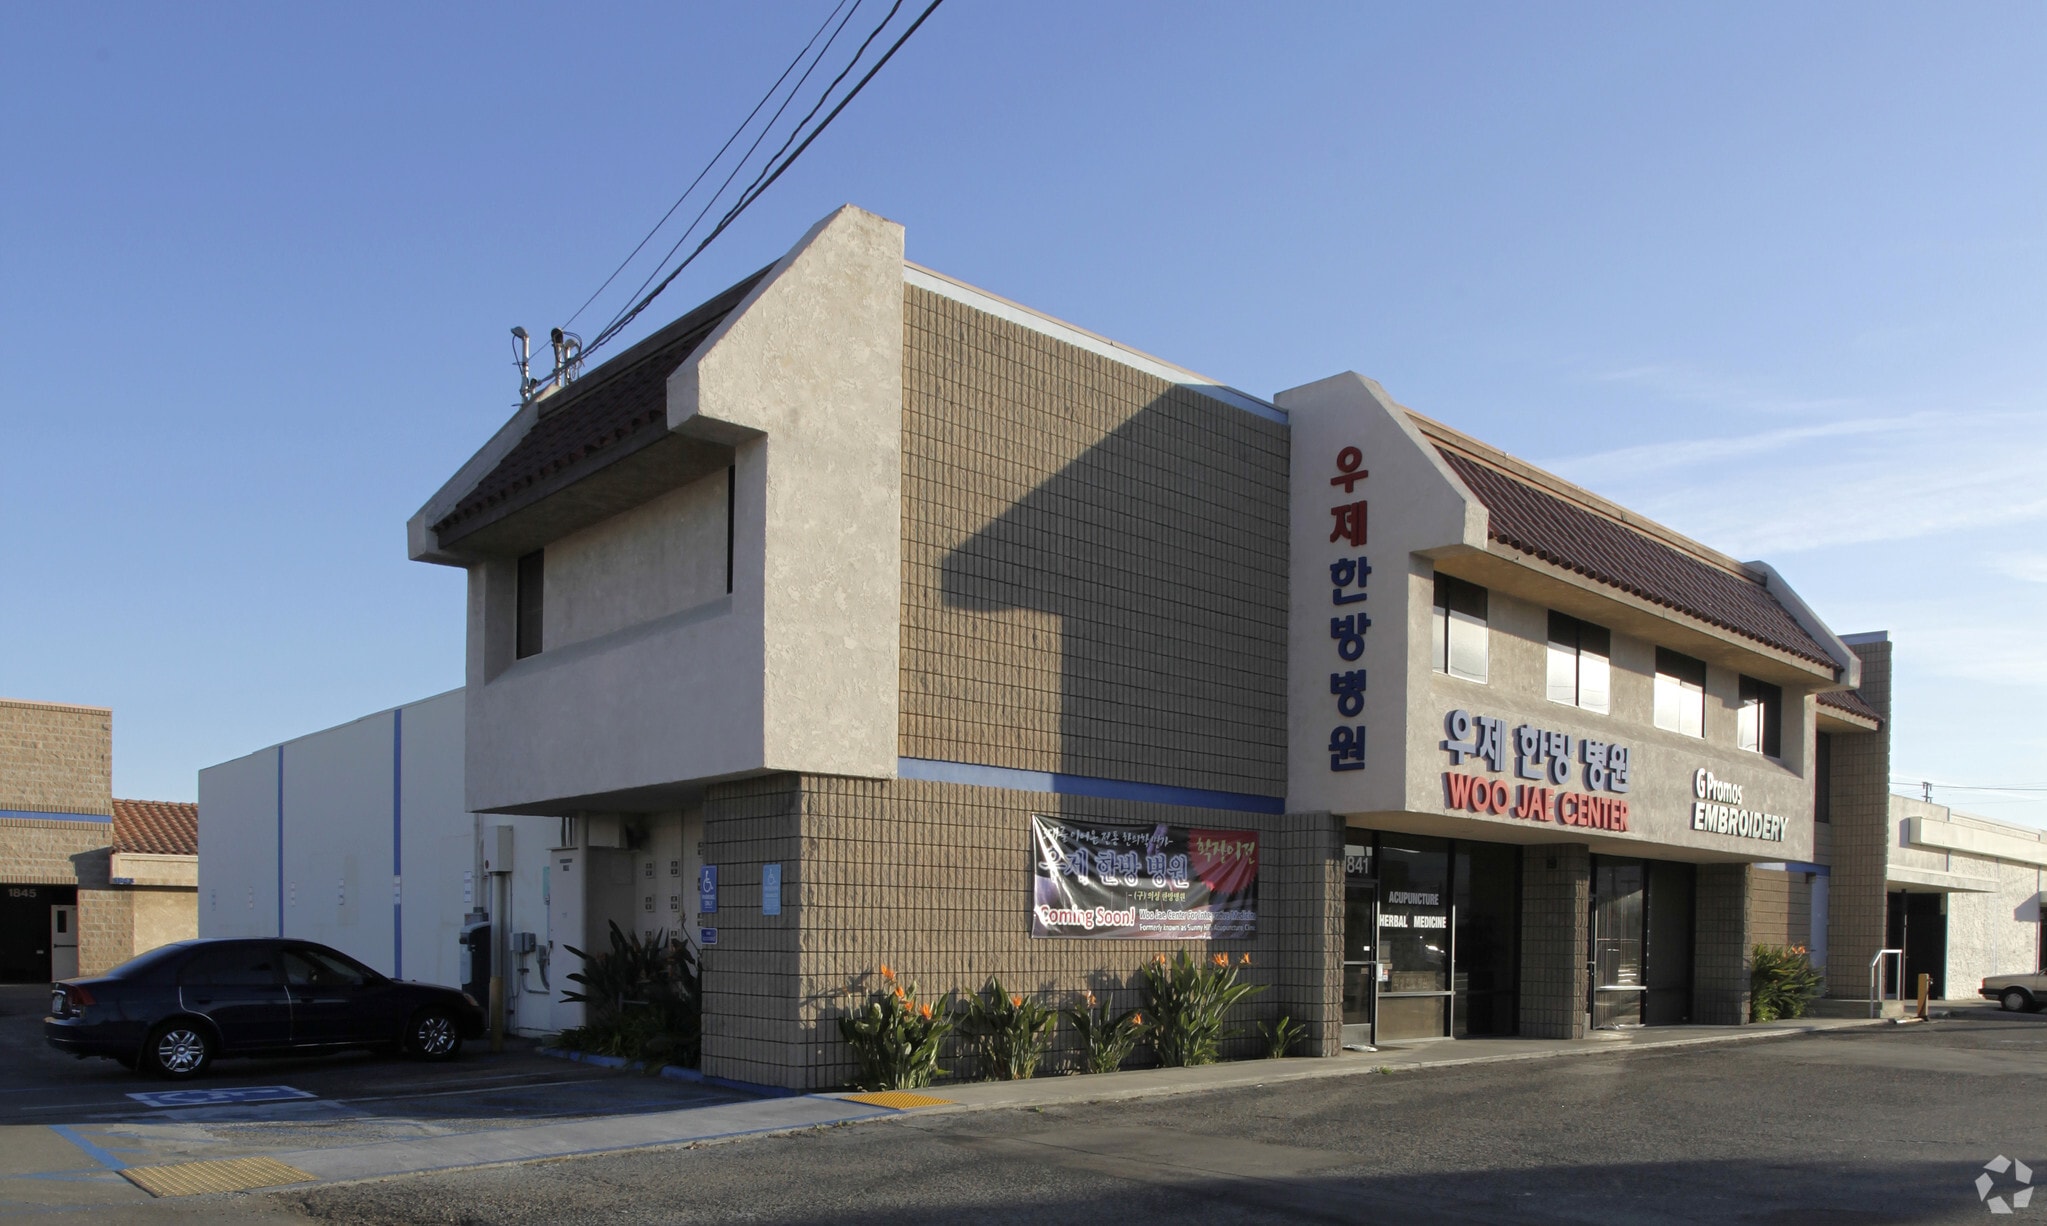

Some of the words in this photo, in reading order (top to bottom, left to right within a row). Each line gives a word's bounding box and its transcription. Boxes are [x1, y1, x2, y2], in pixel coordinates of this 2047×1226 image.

[1440, 709, 1507, 772] 우제
[1513, 724, 1575, 785] 한방
[1579, 739, 1631, 793] 병원
[1707, 771, 1743, 805] Promos
[1444, 772, 1510, 815] WOO
[1513, 784, 1555, 821] JAE
[1558, 791, 1630, 831] CENTER
[1693, 801, 1790, 842] EMBROIDERY
[1096, 851, 1142, 886] 한방
[1147, 853, 1189, 888] 병원
[8, 888, 36, 898] 1845
[1388, 891, 1439, 906] ACUPUNCTURE
[1040, 905, 1094, 929] Coming
[1096, 906, 1135, 926] Soon!
[1139, 909, 1154, 921] Woo
[1167, 910, 1187, 921] Center
[1380, 913, 1408, 928] HERBAL
[1414, 915, 1447, 929] MEDICINE
[1139, 923, 1162, 932] Formerly
[1187, 924, 1204, 932] Sunny
